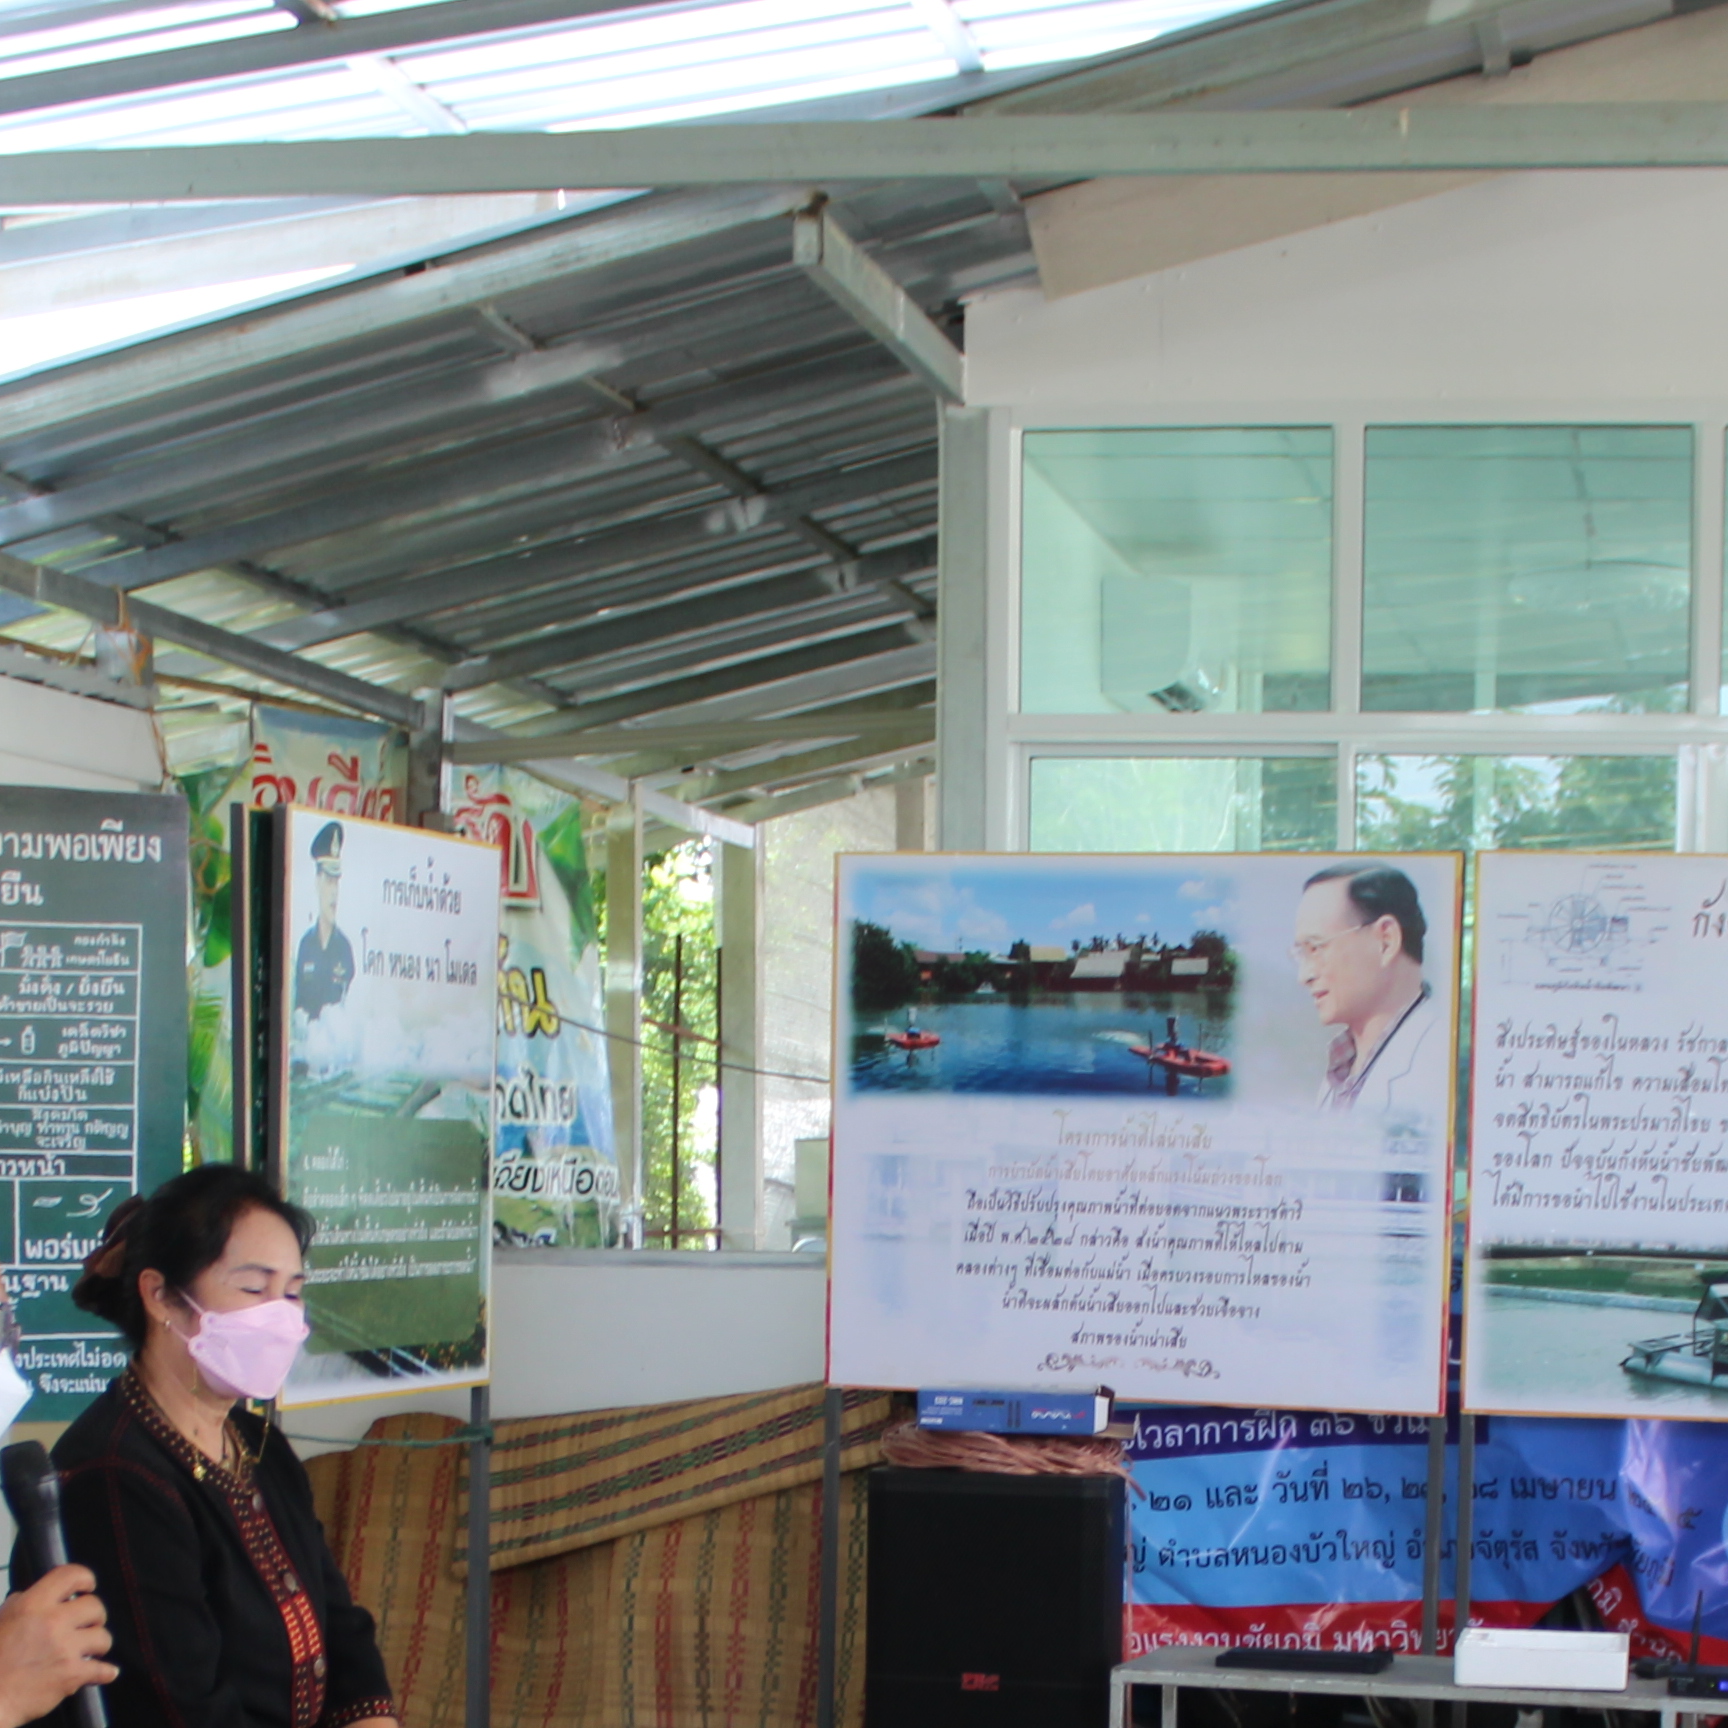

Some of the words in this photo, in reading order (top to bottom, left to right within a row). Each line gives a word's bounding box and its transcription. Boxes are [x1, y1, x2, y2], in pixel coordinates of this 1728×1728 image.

[361, 926, 385, 976] โคก
[389, 951, 421, 981] หนอง
[425, 956, 440, 982] นา
[1205, 1483, 1259, 1510] และ
[1272, 1460, 1329, 1504] วันที่
[1510, 1476, 1617, 1501] เมษายน
[1157, 1529, 1396, 1570] ตำบลหนองบัวใหญ่
